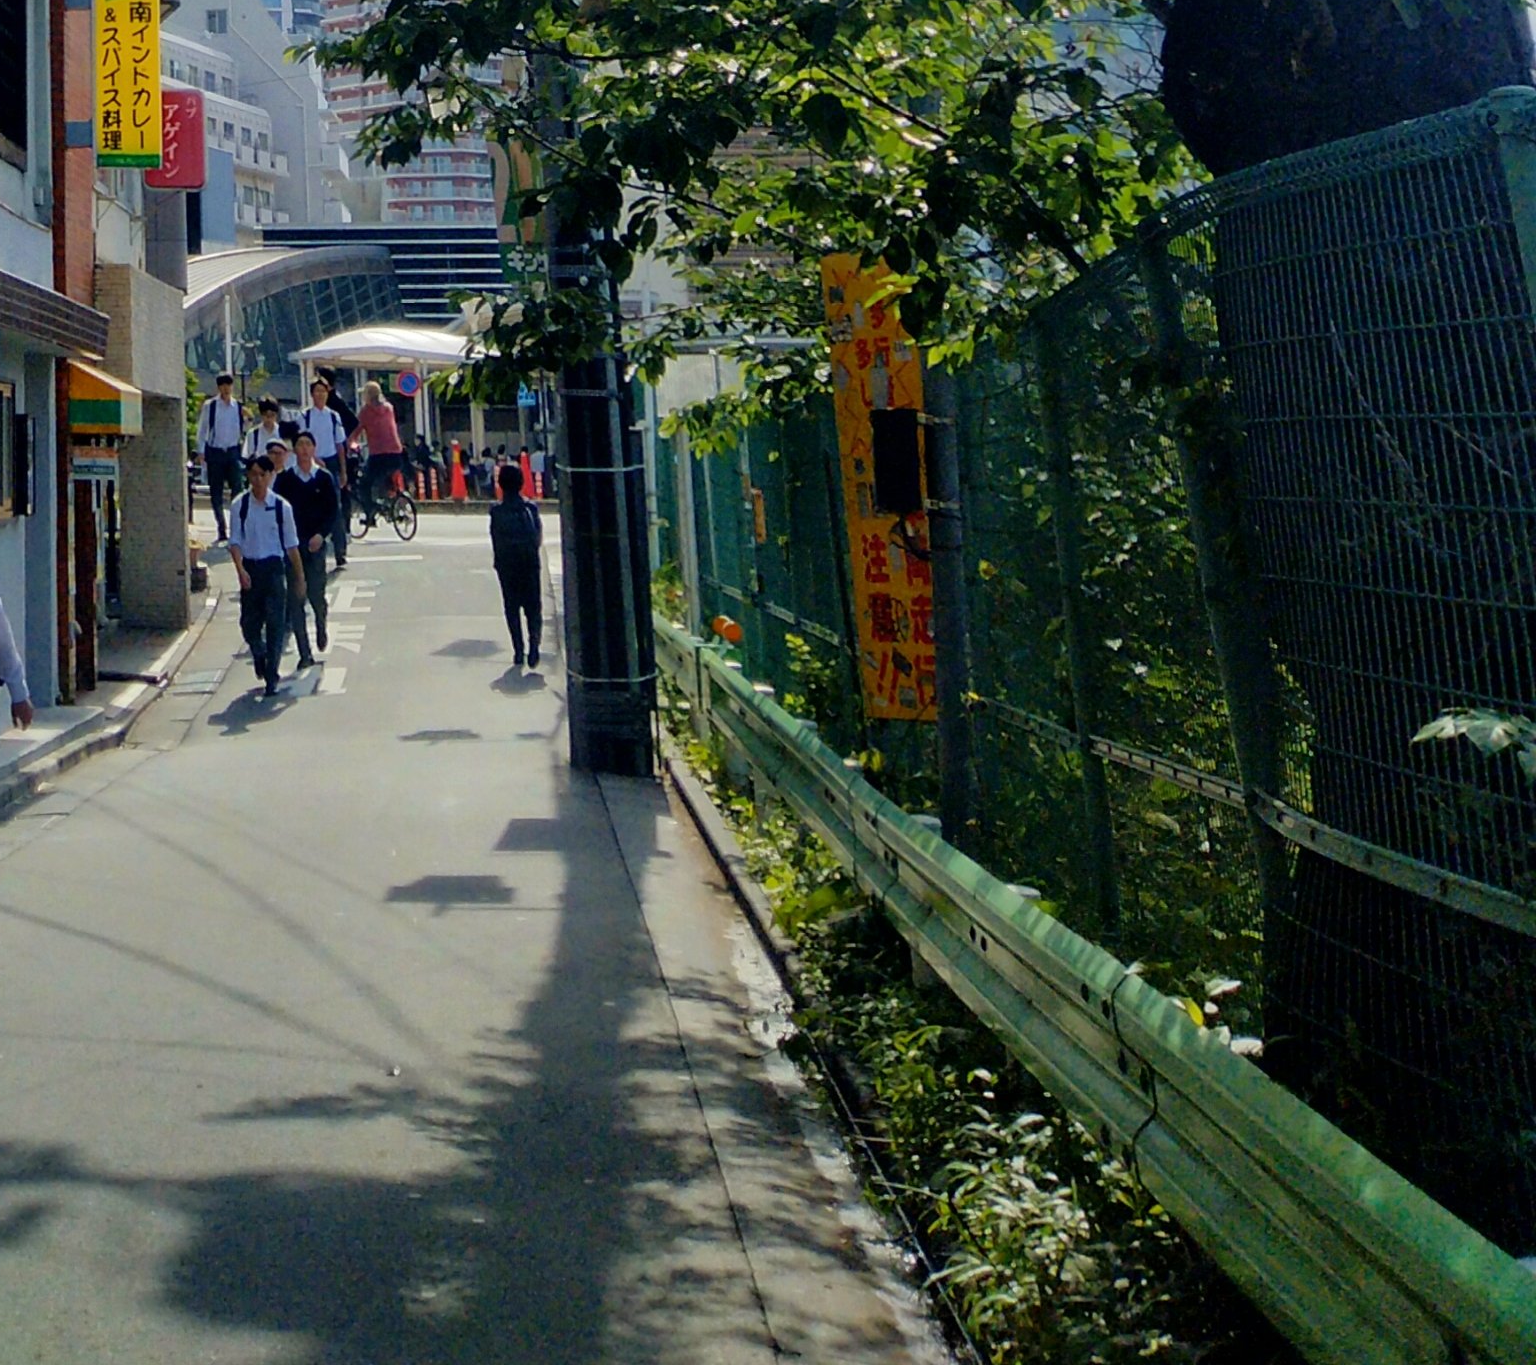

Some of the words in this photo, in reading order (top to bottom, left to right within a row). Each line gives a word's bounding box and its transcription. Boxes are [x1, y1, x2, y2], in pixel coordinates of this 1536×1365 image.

[128, 1, 151, 150] 南インドカレー
[163, 103, 182, 179] アゲイン
